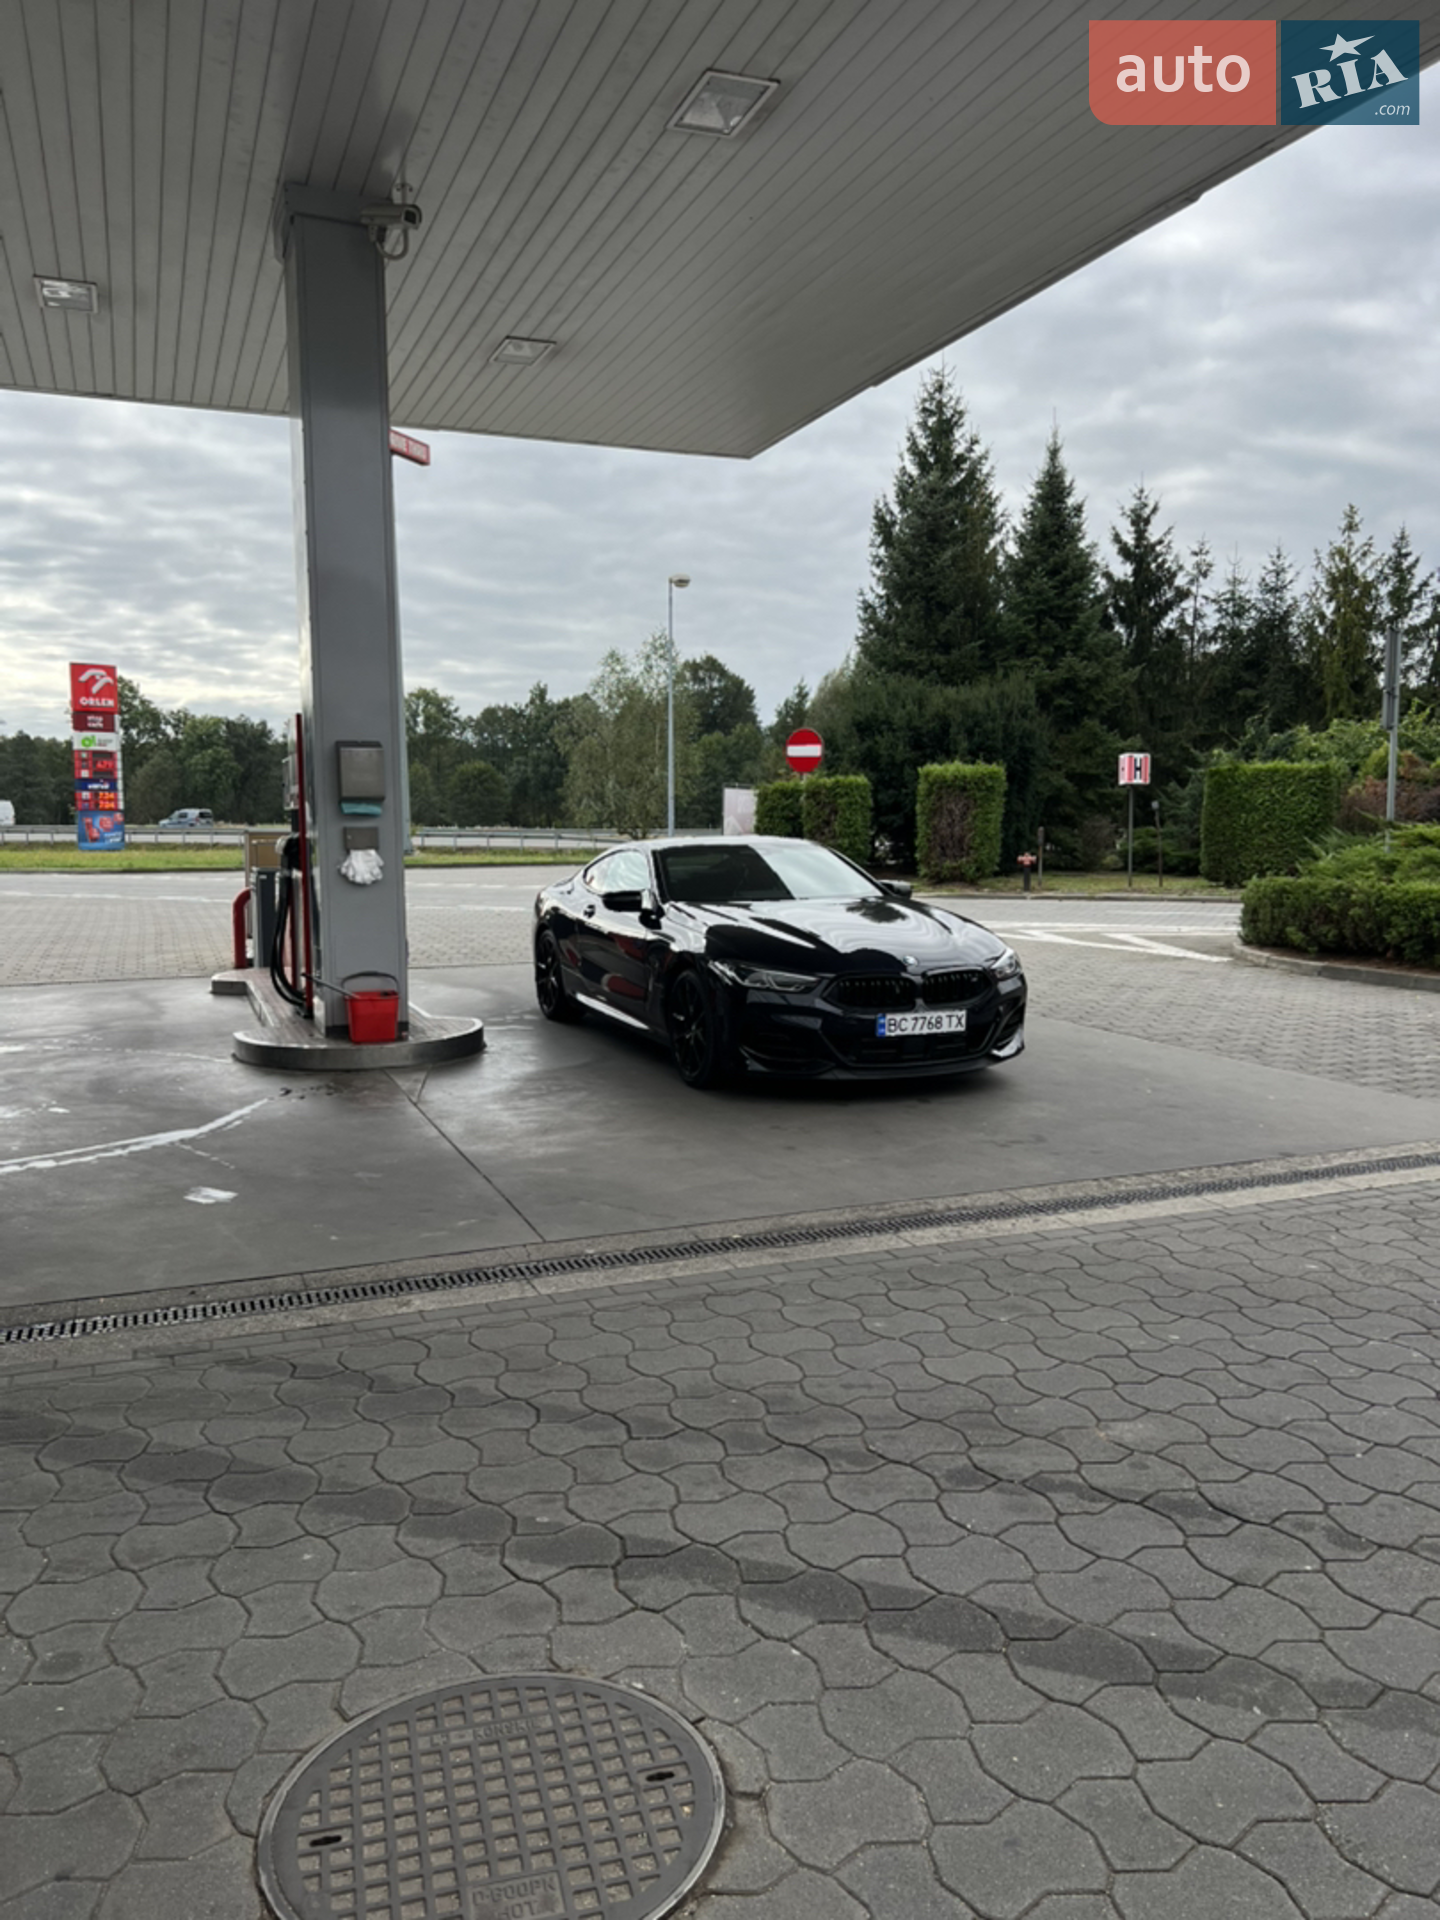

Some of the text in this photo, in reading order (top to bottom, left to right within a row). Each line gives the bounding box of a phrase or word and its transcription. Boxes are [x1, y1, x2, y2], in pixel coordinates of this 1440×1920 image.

[79, 697, 114, 708] ORLEN
[887, 1018, 909, 1033] BC
[910, 1016, 943, 1031] 7768
[945, 1014, 965, 1028] TX
